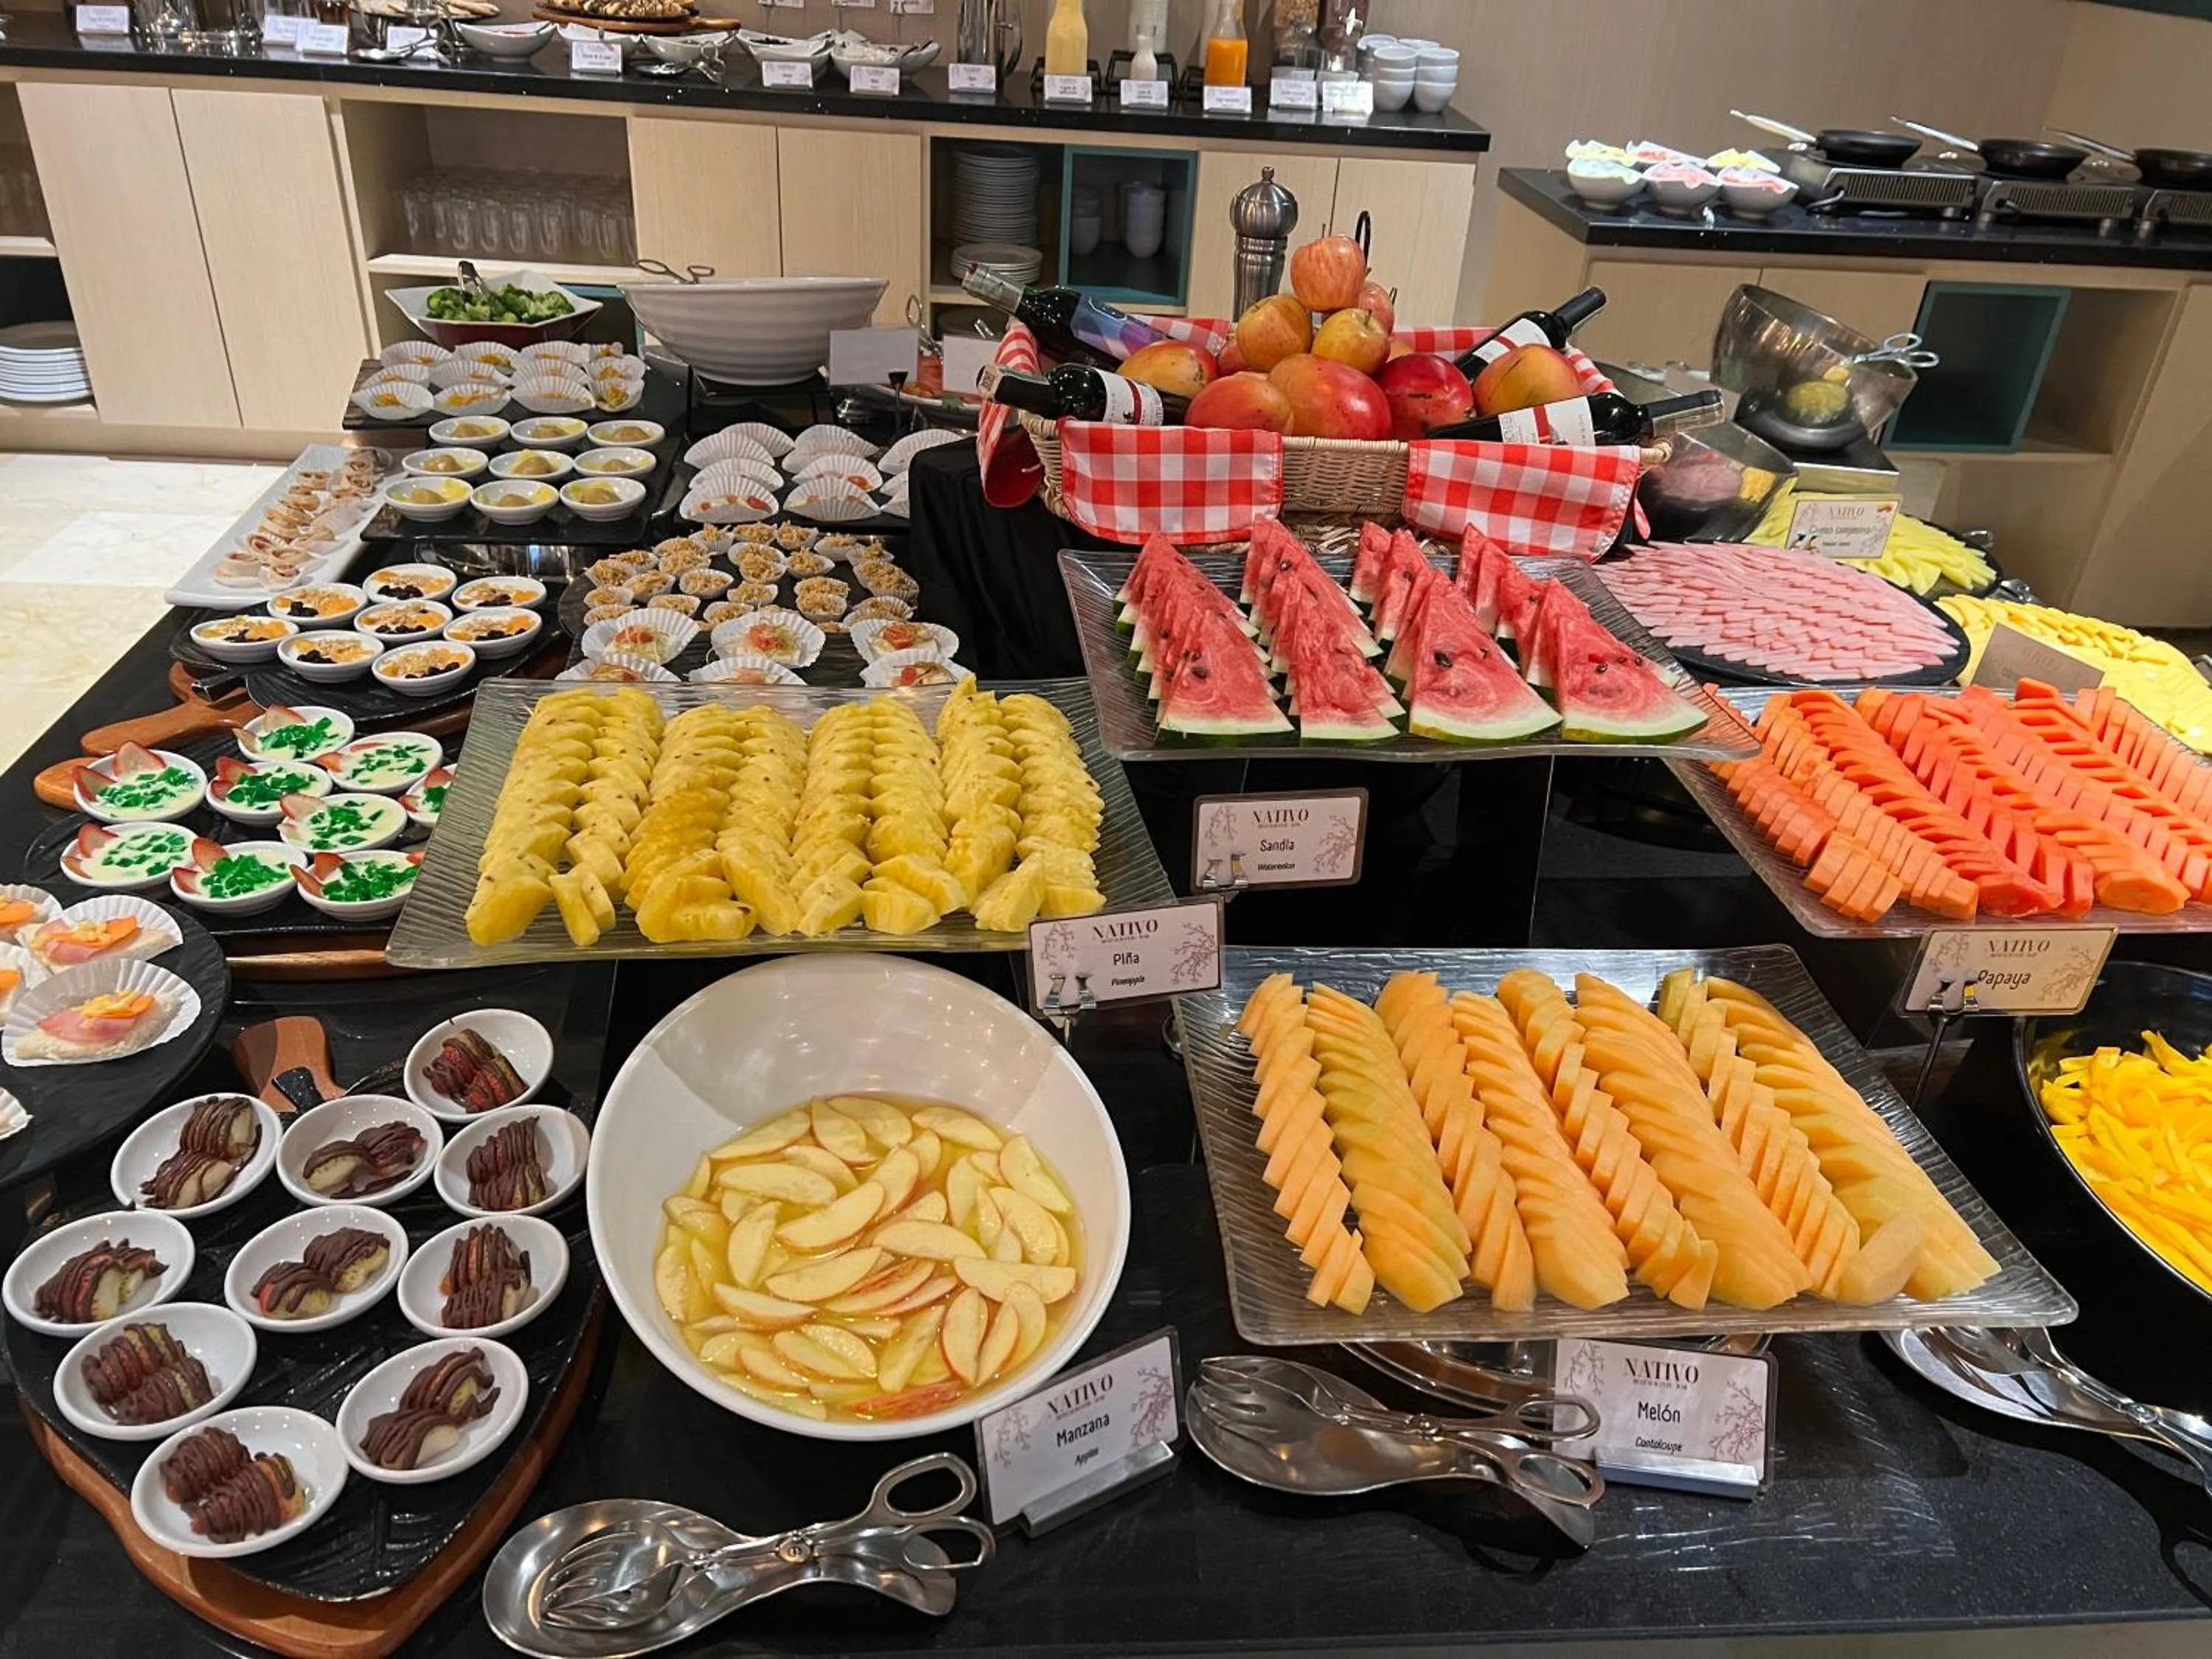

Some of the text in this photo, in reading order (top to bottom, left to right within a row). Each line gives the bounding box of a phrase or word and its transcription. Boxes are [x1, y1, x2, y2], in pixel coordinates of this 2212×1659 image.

[1251, 808, 1310, 824] NATIVO
[1093, 919, 1158, 940] NATIVO
[1985, 939, 2051, 953] NATIVO
[1113, 951, 1140, 966] Piña
[1977, 969, 2031, 990] Papaya
[1624, 1357, 1699, 1384] NATIVO
[1047, 1374, 1113, 1417] NATIVO
[1638, 1401, 1681, 1424] Melón
[1056, 1413, 1110, 1448] Manzana
[1635, 1436, 1683, 1455] Cantaloupe
